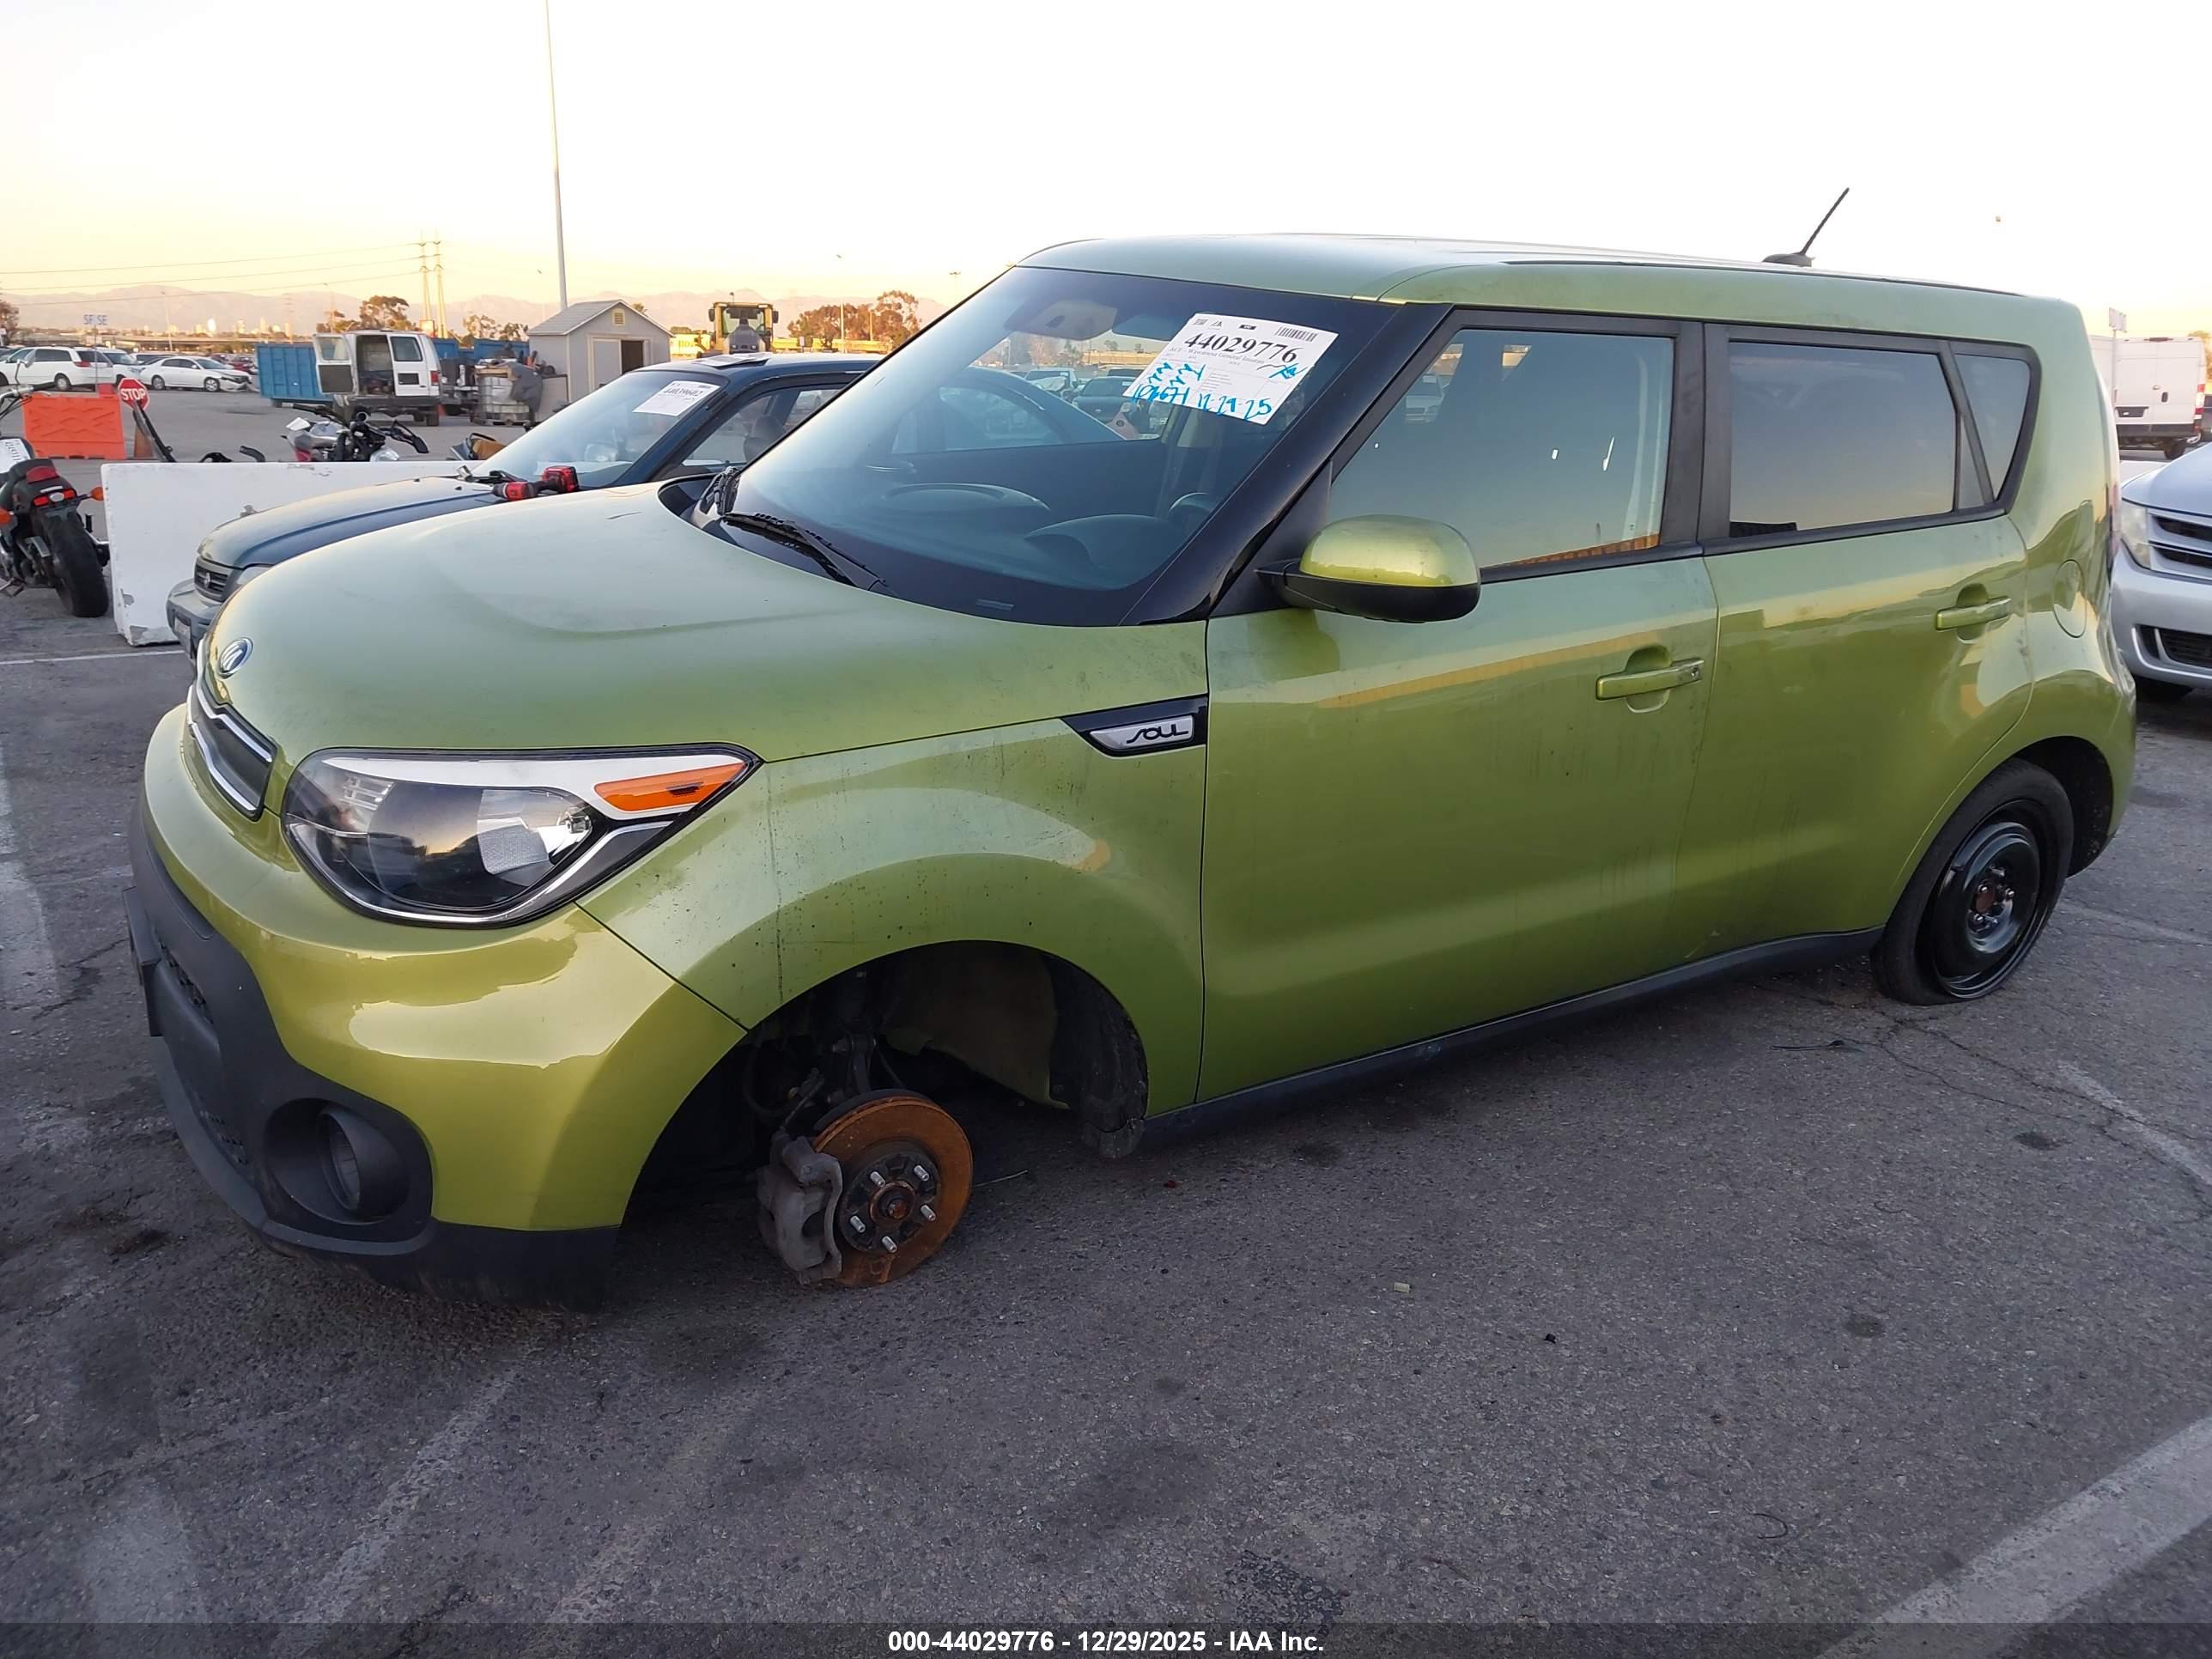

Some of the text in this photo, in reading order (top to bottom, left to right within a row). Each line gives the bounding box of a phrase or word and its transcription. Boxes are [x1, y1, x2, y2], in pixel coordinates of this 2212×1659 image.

[1184, 332, 1304, 362] 44029776
[121, 388, 145, 400] STOP
[1126, 723, 1189, 744] SOUL
